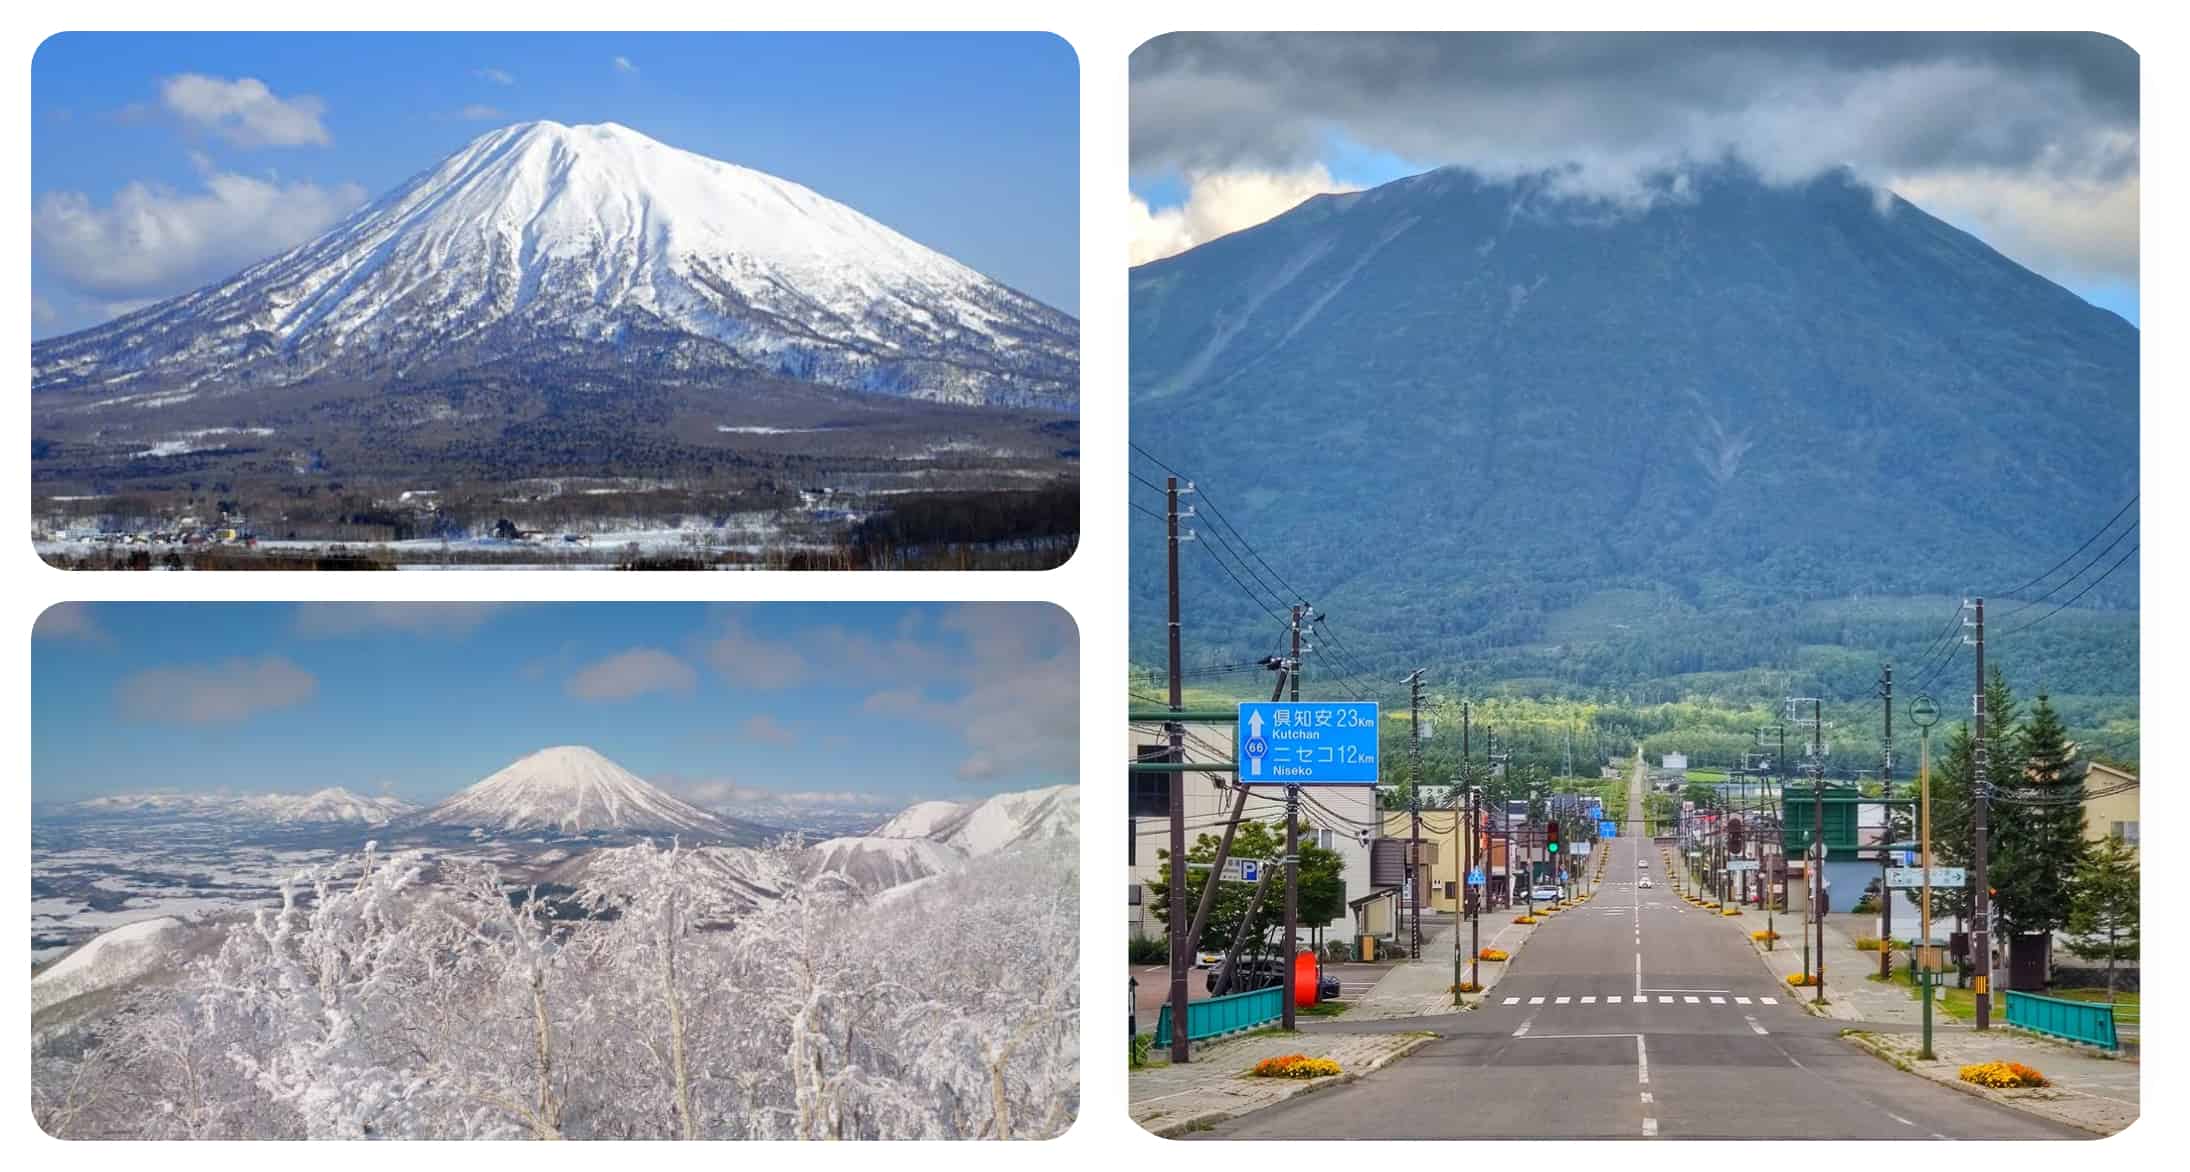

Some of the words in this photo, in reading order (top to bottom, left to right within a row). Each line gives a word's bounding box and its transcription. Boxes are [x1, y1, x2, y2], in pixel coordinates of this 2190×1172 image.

[1272, 729, 1320, 739] Kutchan
[1249, 744, 1264, 753] 66
[1273, 746, 1333, 763] ニセコ
[1273, 766, 1312, 776] Niseko
[1243, 861, 1256, 879] P
